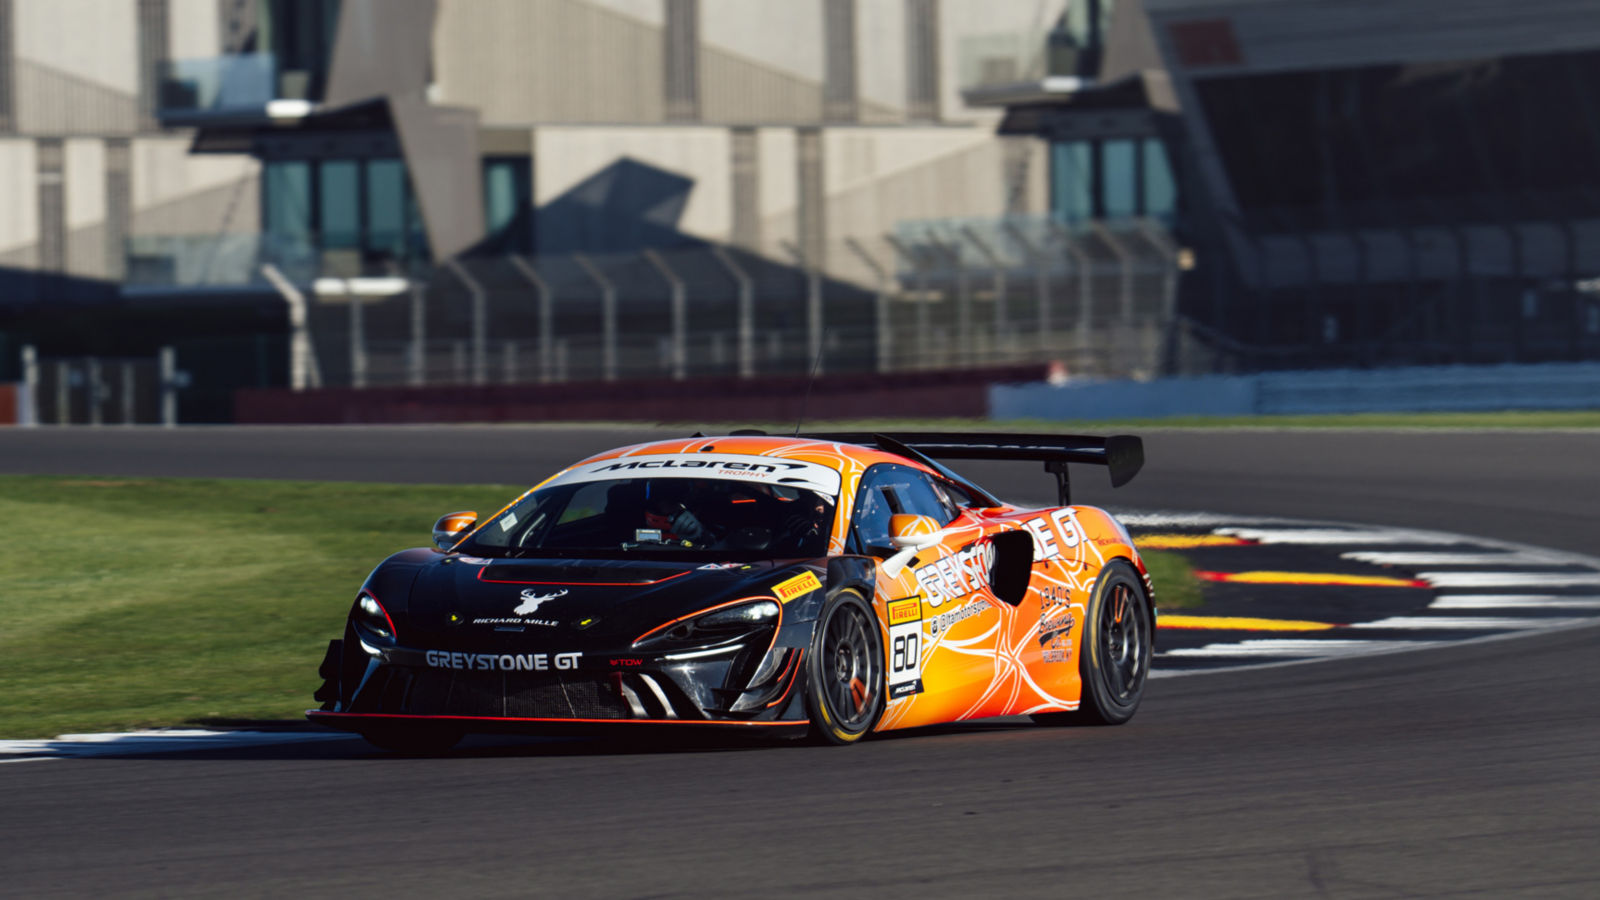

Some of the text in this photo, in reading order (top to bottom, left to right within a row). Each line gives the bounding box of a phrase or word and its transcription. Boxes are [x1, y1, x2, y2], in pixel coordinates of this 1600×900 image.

[590, 460, 777, 473] McLaren
[718, 469, 769, 478] TROPHY
[1050, 507, 1089, 548] GT
[778, 575, 816, 598] PIRELLI
[892, 602, 918, 620] PIRELLI
[524, 619, 559, 627] MILLE
[426, 650, 583, 671] GREYSTONE GT
[893, 632, 918, 673] 80
